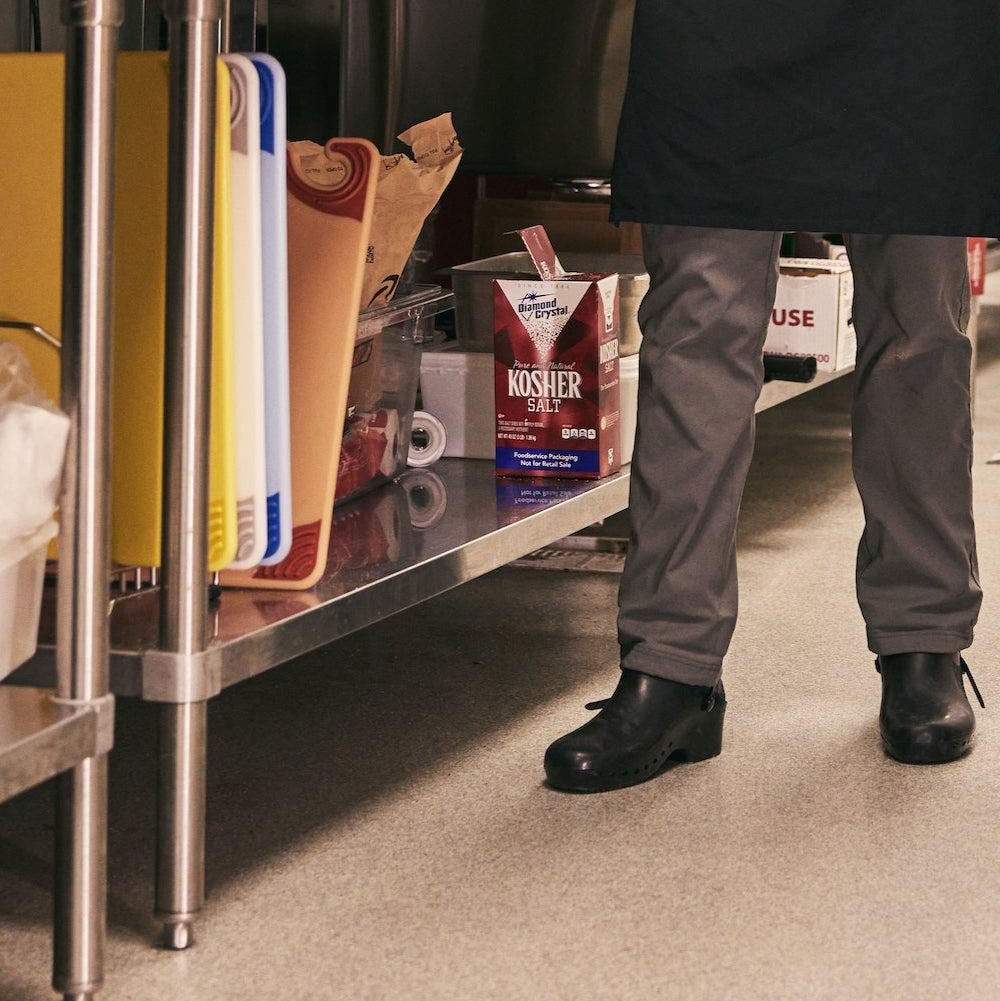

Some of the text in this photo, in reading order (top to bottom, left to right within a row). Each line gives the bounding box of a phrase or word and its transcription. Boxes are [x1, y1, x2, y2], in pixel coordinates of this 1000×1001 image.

[518, 298, 557, 312] Diamond
[535, 306, 568, 319] Crystal
[513, 360, 531, 369] Pure
[547, 361, 576, 370] Natural
[508, 369, 582, 399] KOSHER
[527, 398, 561, 412] SALT
[514, 452, 578, 462] Foodservice Packaging
